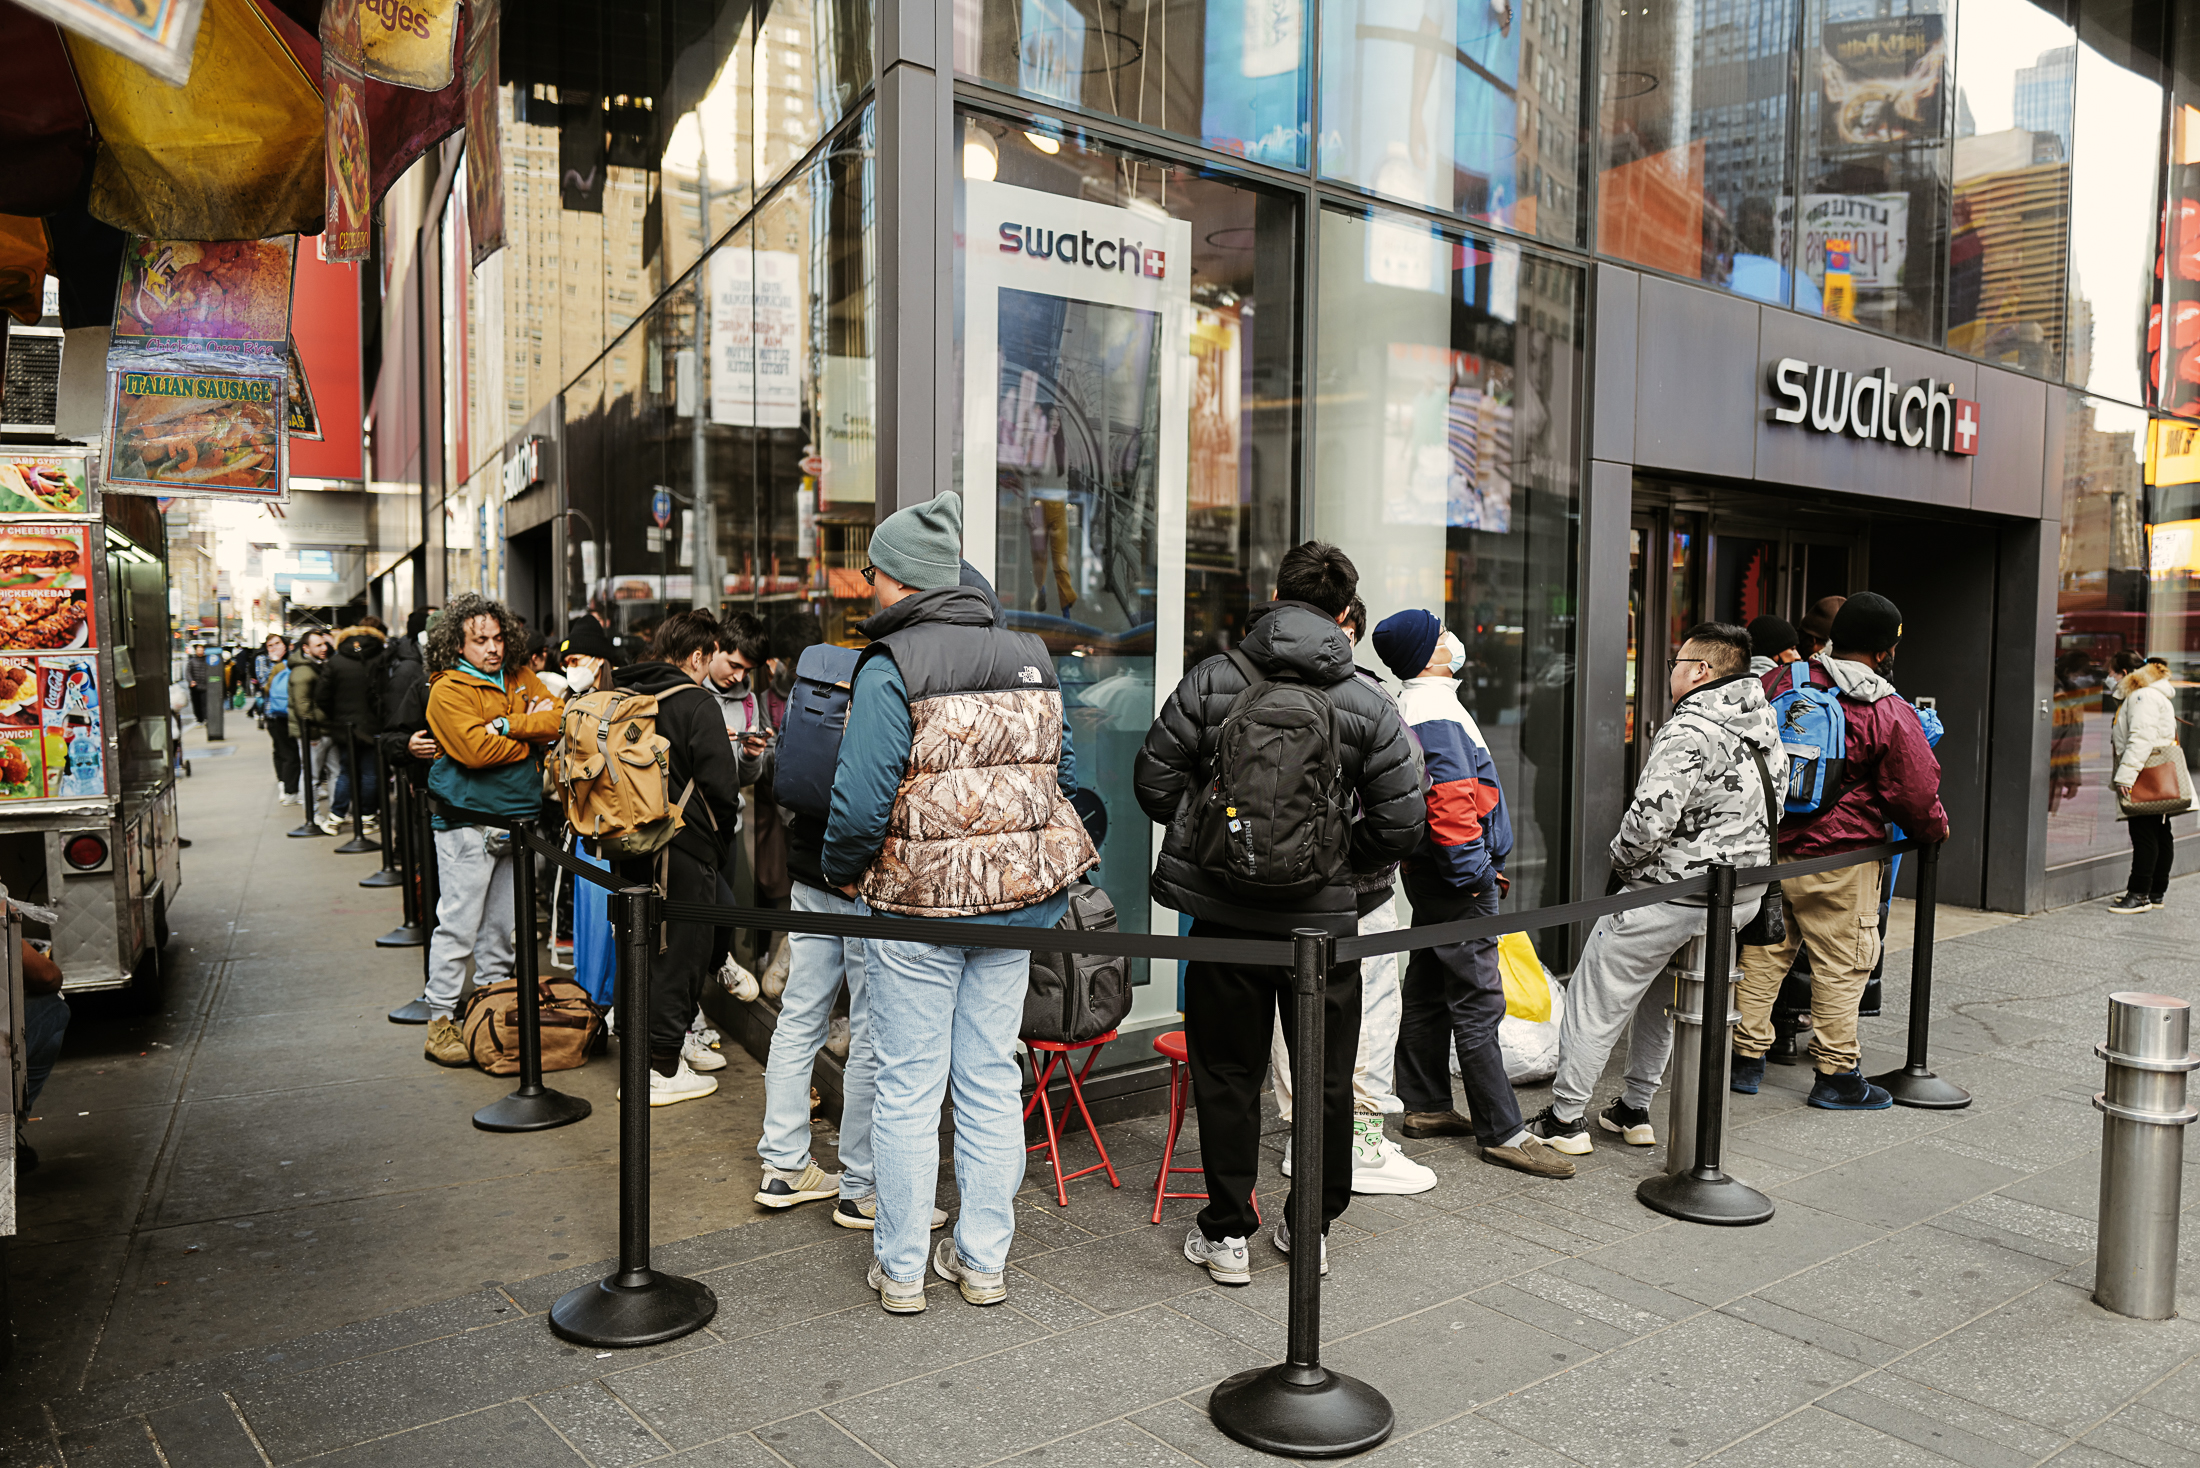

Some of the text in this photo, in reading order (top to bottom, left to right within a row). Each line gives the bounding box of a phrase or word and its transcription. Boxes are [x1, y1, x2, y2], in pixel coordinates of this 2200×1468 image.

[361, 0, 430, 39] ages
[999, 222, 1141, 276] swatch
[146, 338, 202, 351] Chicken
[206, 340, 240, 353] Over
[243, 342, 274, 355] Rice
[125, 374, 272, 402] ITALIAN SAUSAGE
[1770, 357, 1952, 452] swatch
[10, 457, 62, 466] LAMB GYRO
[503, 434, 532, 501] swatch
[7, 526, 47, 535] CHEESE
[49, 526, 84, 535] STEAK
[36, 589, 72, 598] KEBAB
[2, 657, 29, 667] RICE
[1243, 820, 1257, 876] patagonia
